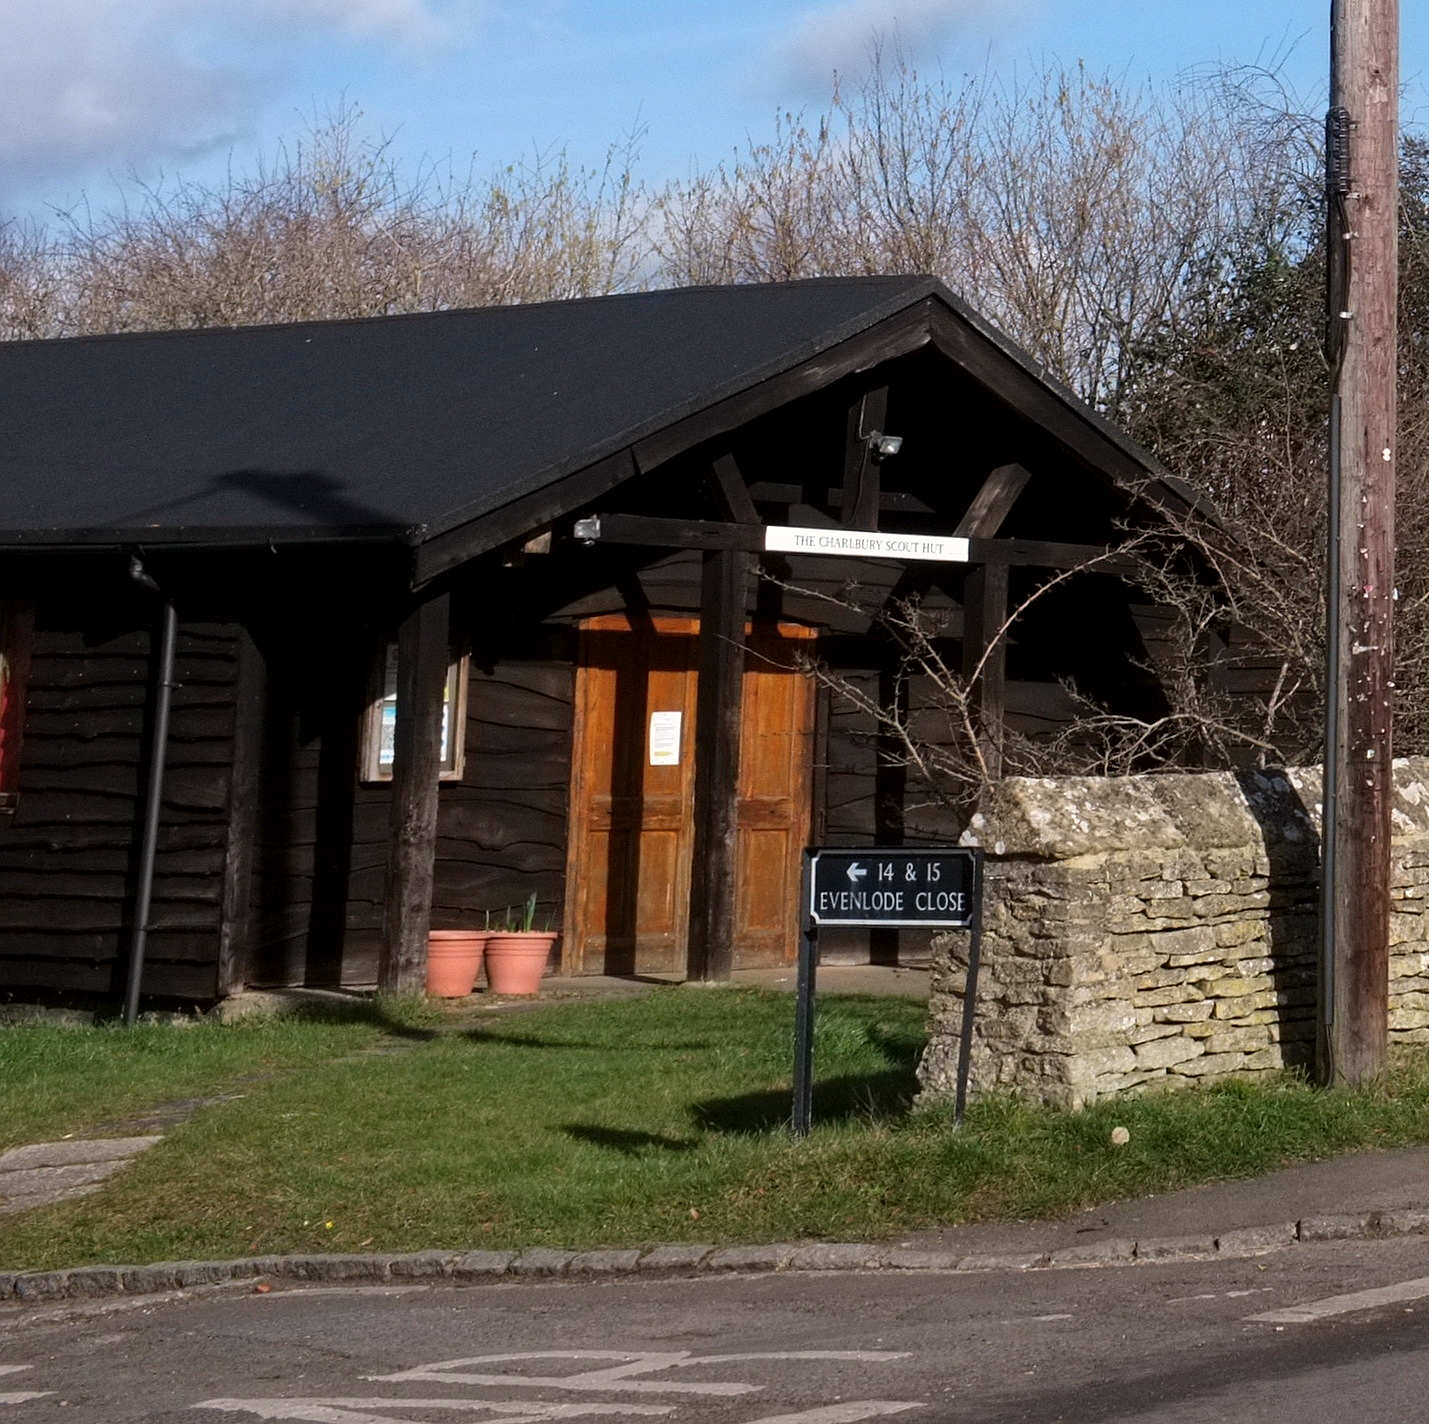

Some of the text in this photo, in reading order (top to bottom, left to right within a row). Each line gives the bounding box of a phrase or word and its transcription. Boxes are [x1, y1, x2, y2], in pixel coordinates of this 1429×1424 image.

[793, 534, 945, 555] THE CHARLBURY SCOUT HUT
[878, 862, 942, 882] 14 & 15
[820, 891, 966, 913] EVENLODE CLOSE
